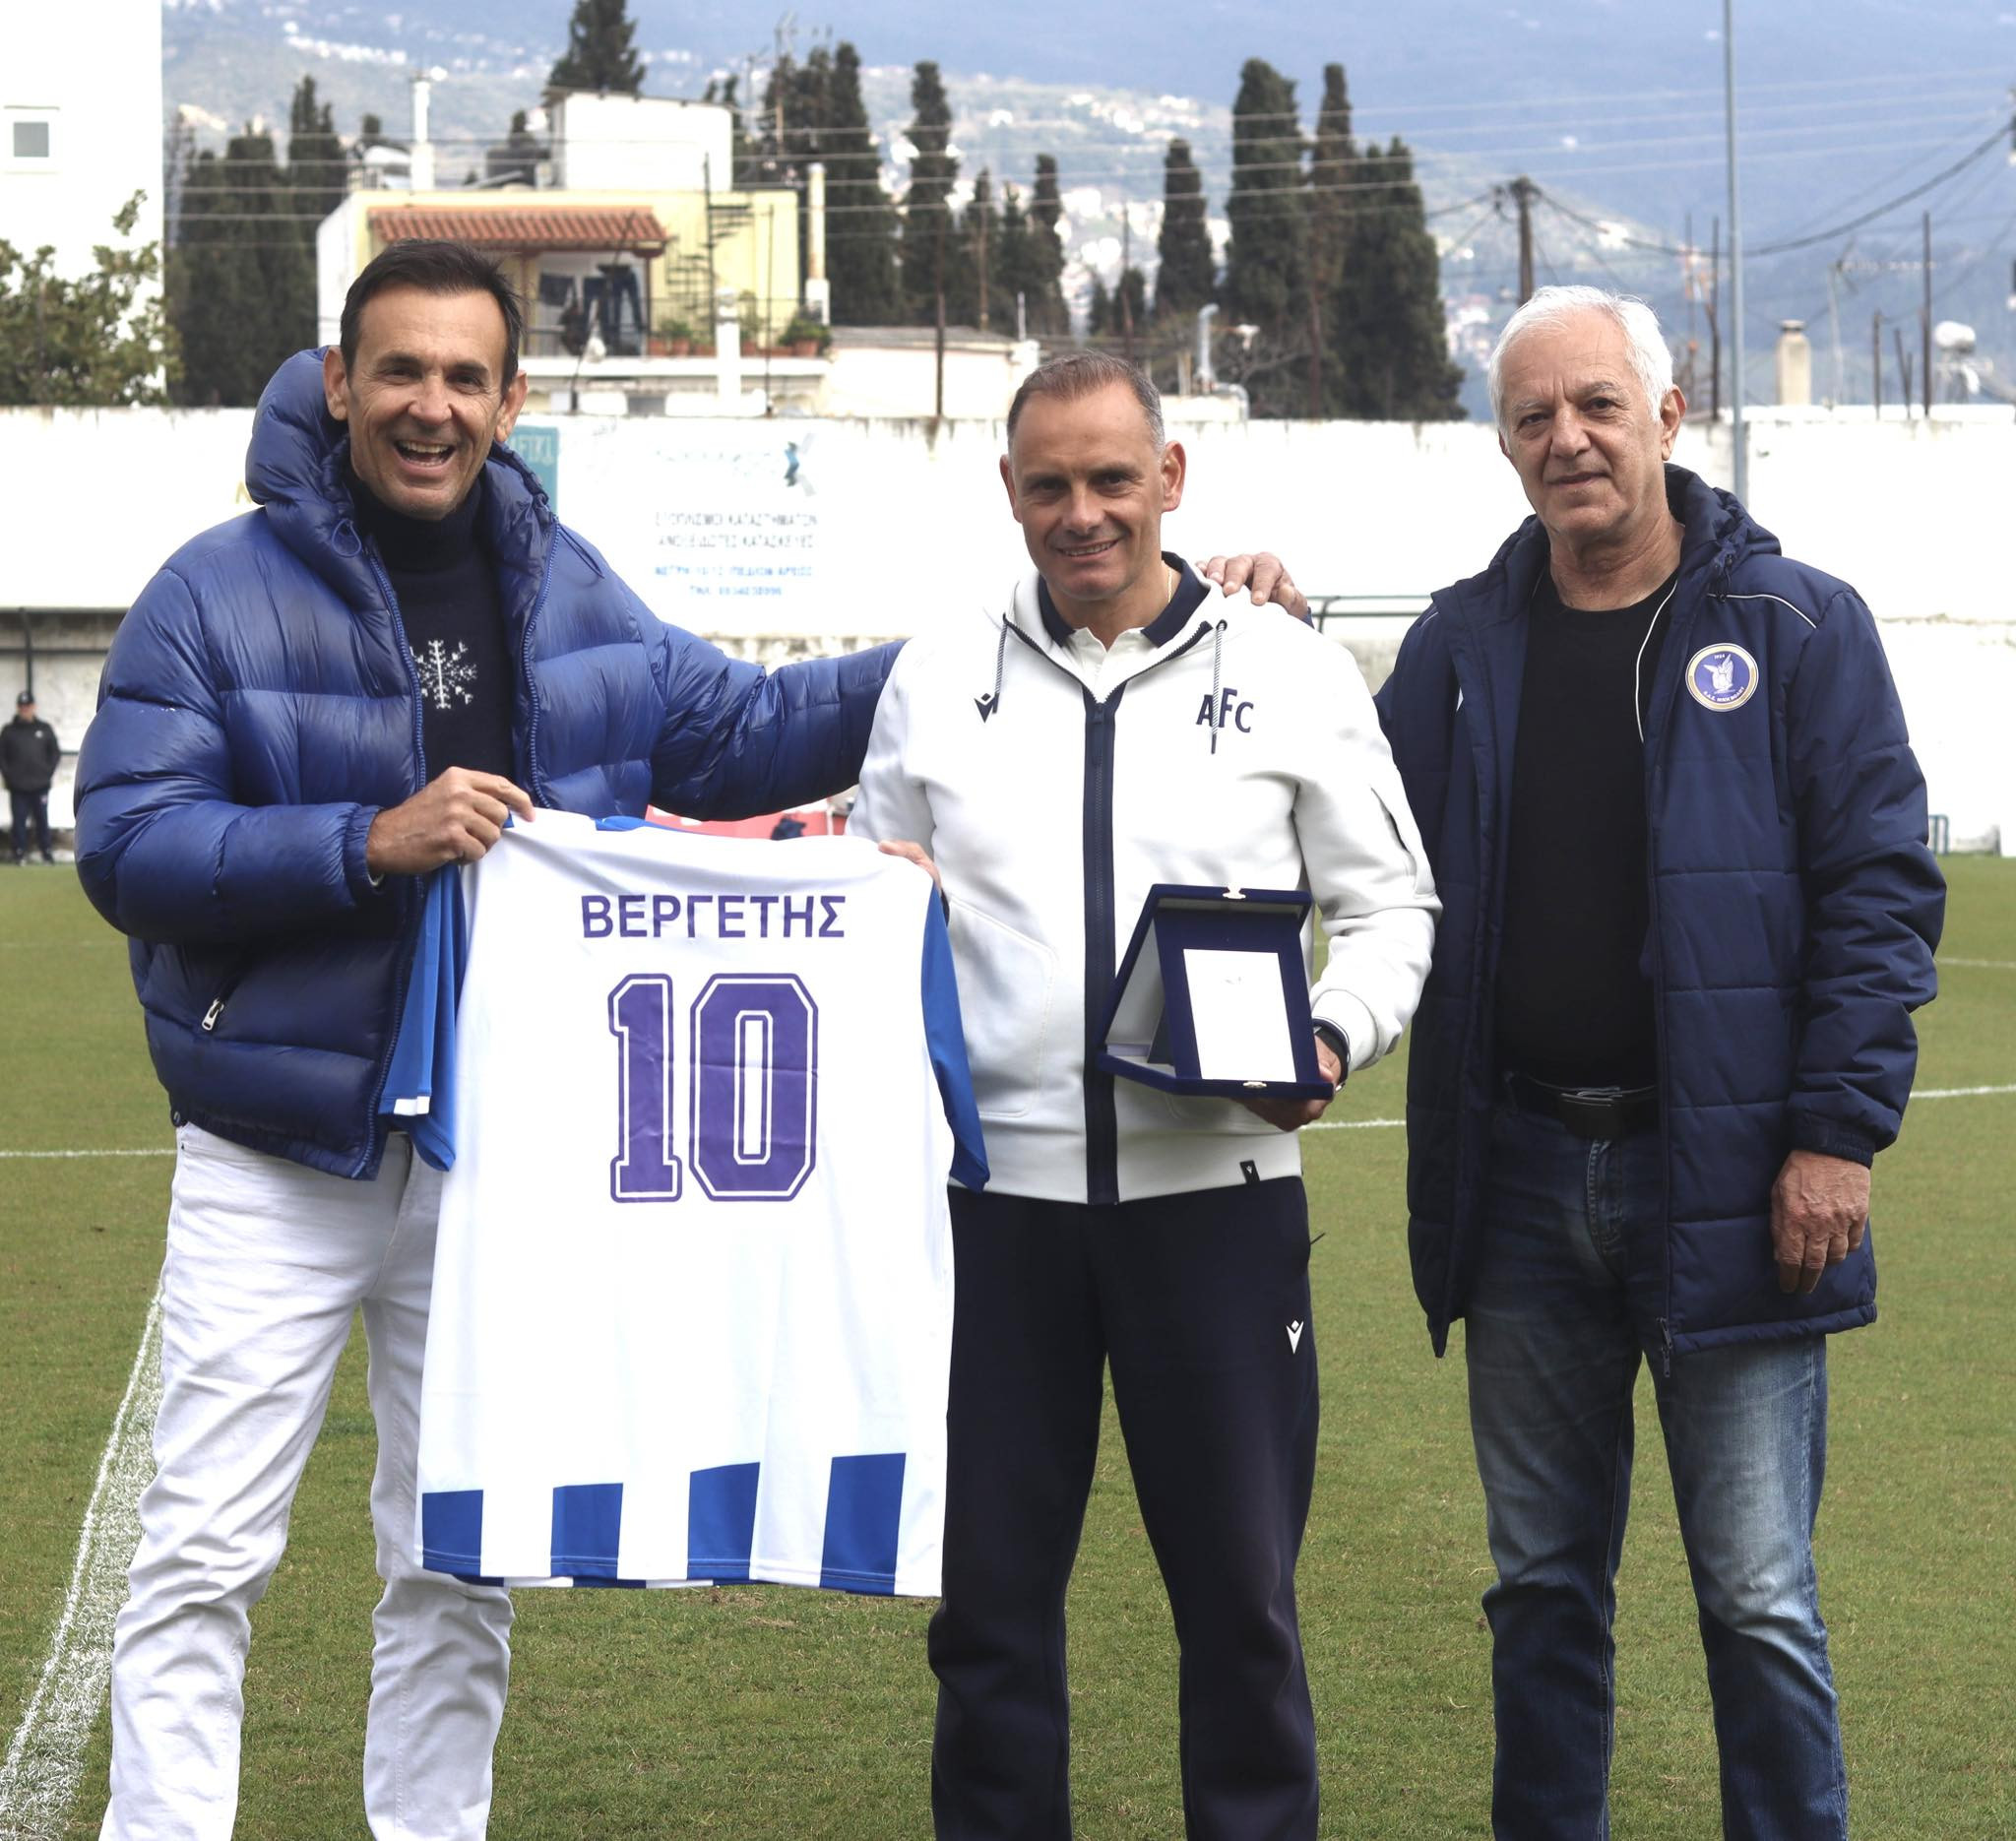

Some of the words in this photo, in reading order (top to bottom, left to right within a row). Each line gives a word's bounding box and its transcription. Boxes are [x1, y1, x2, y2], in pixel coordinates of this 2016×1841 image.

[1195, 687, 1254, 733] AFC
[581, 894, 846, 938] ΒΕΡΓΕΤΗΣ
[607, 973, 819, 1203] 10
